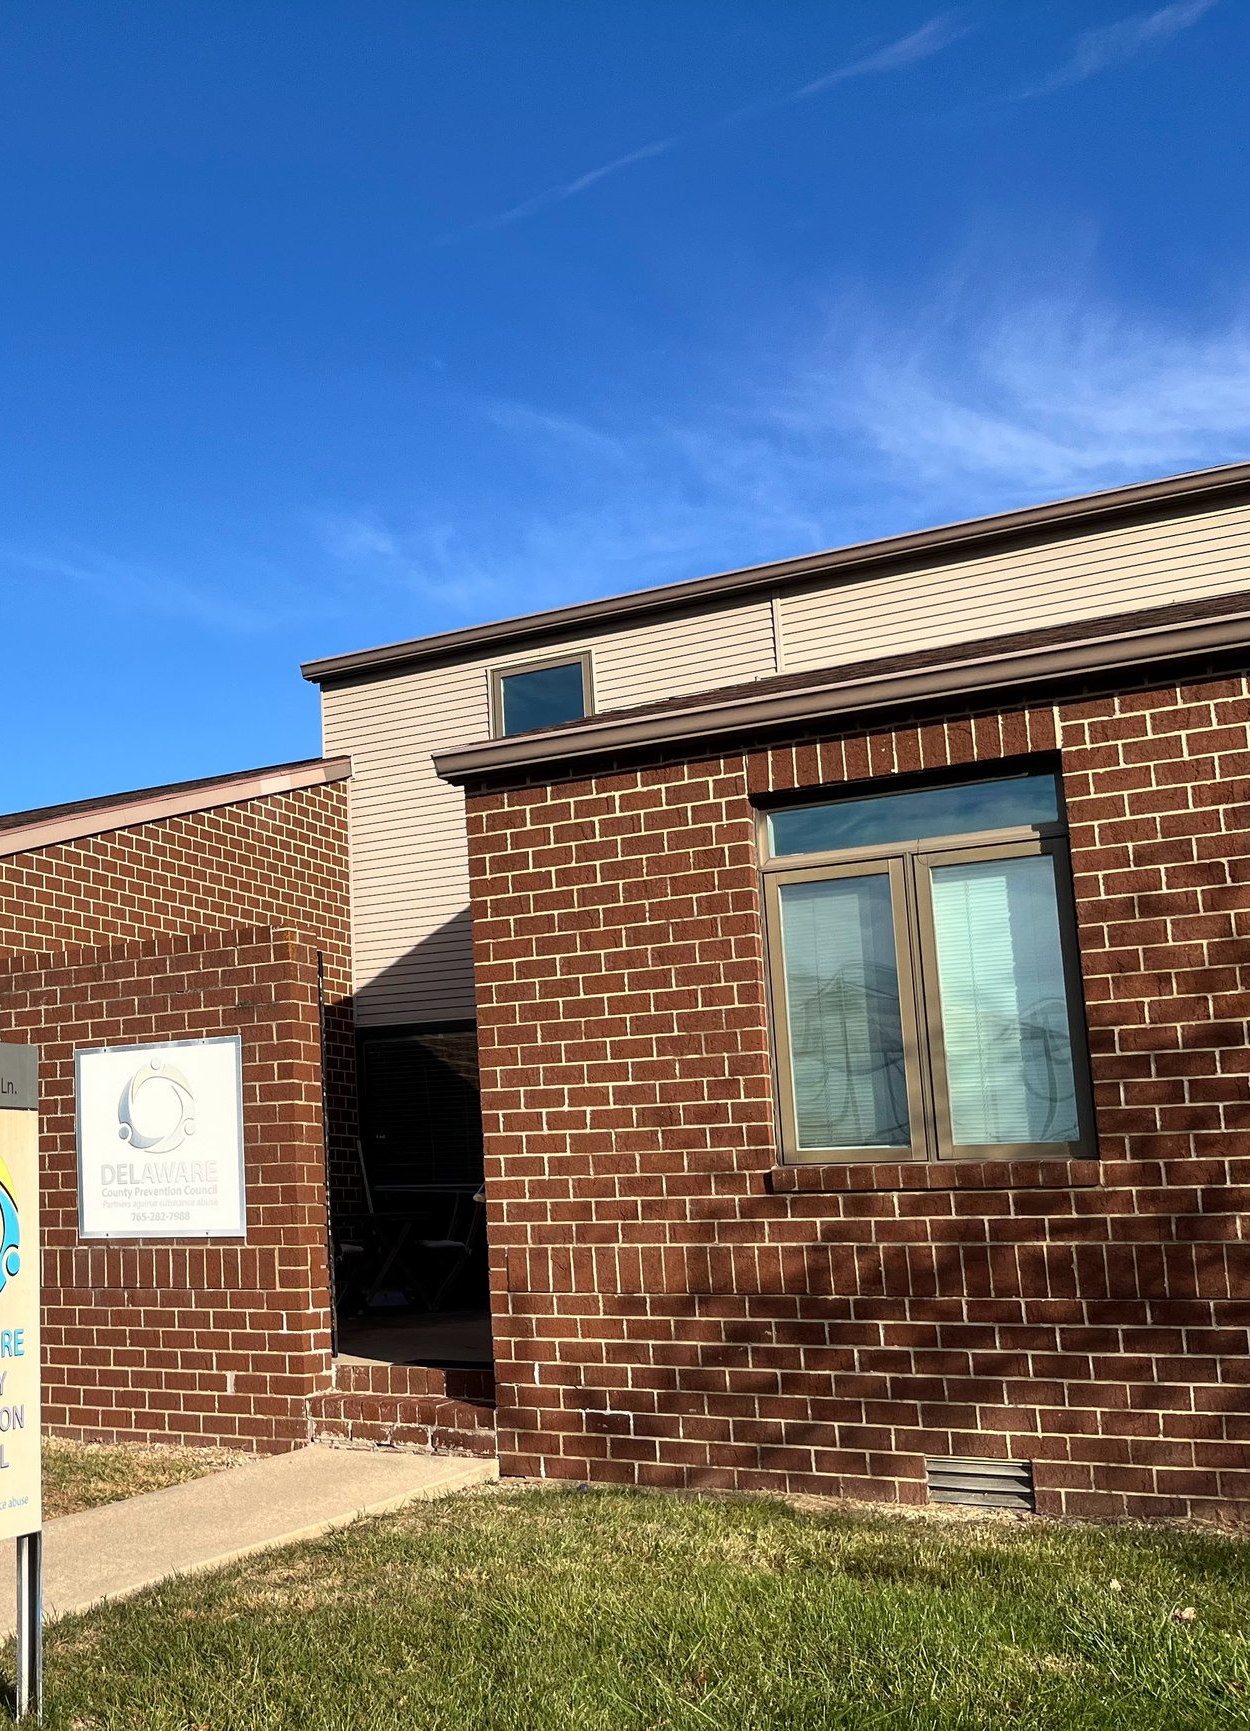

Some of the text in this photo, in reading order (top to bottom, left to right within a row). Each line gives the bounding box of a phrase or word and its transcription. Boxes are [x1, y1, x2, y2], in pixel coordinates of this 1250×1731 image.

[1, 1078, 18, 1095] Ln.
[100, 1160, 219, 1186] DELAWARE
[101, 1184, 218, 1199] County Prevention Council
[7, 1495, 29, 1509] abuse
